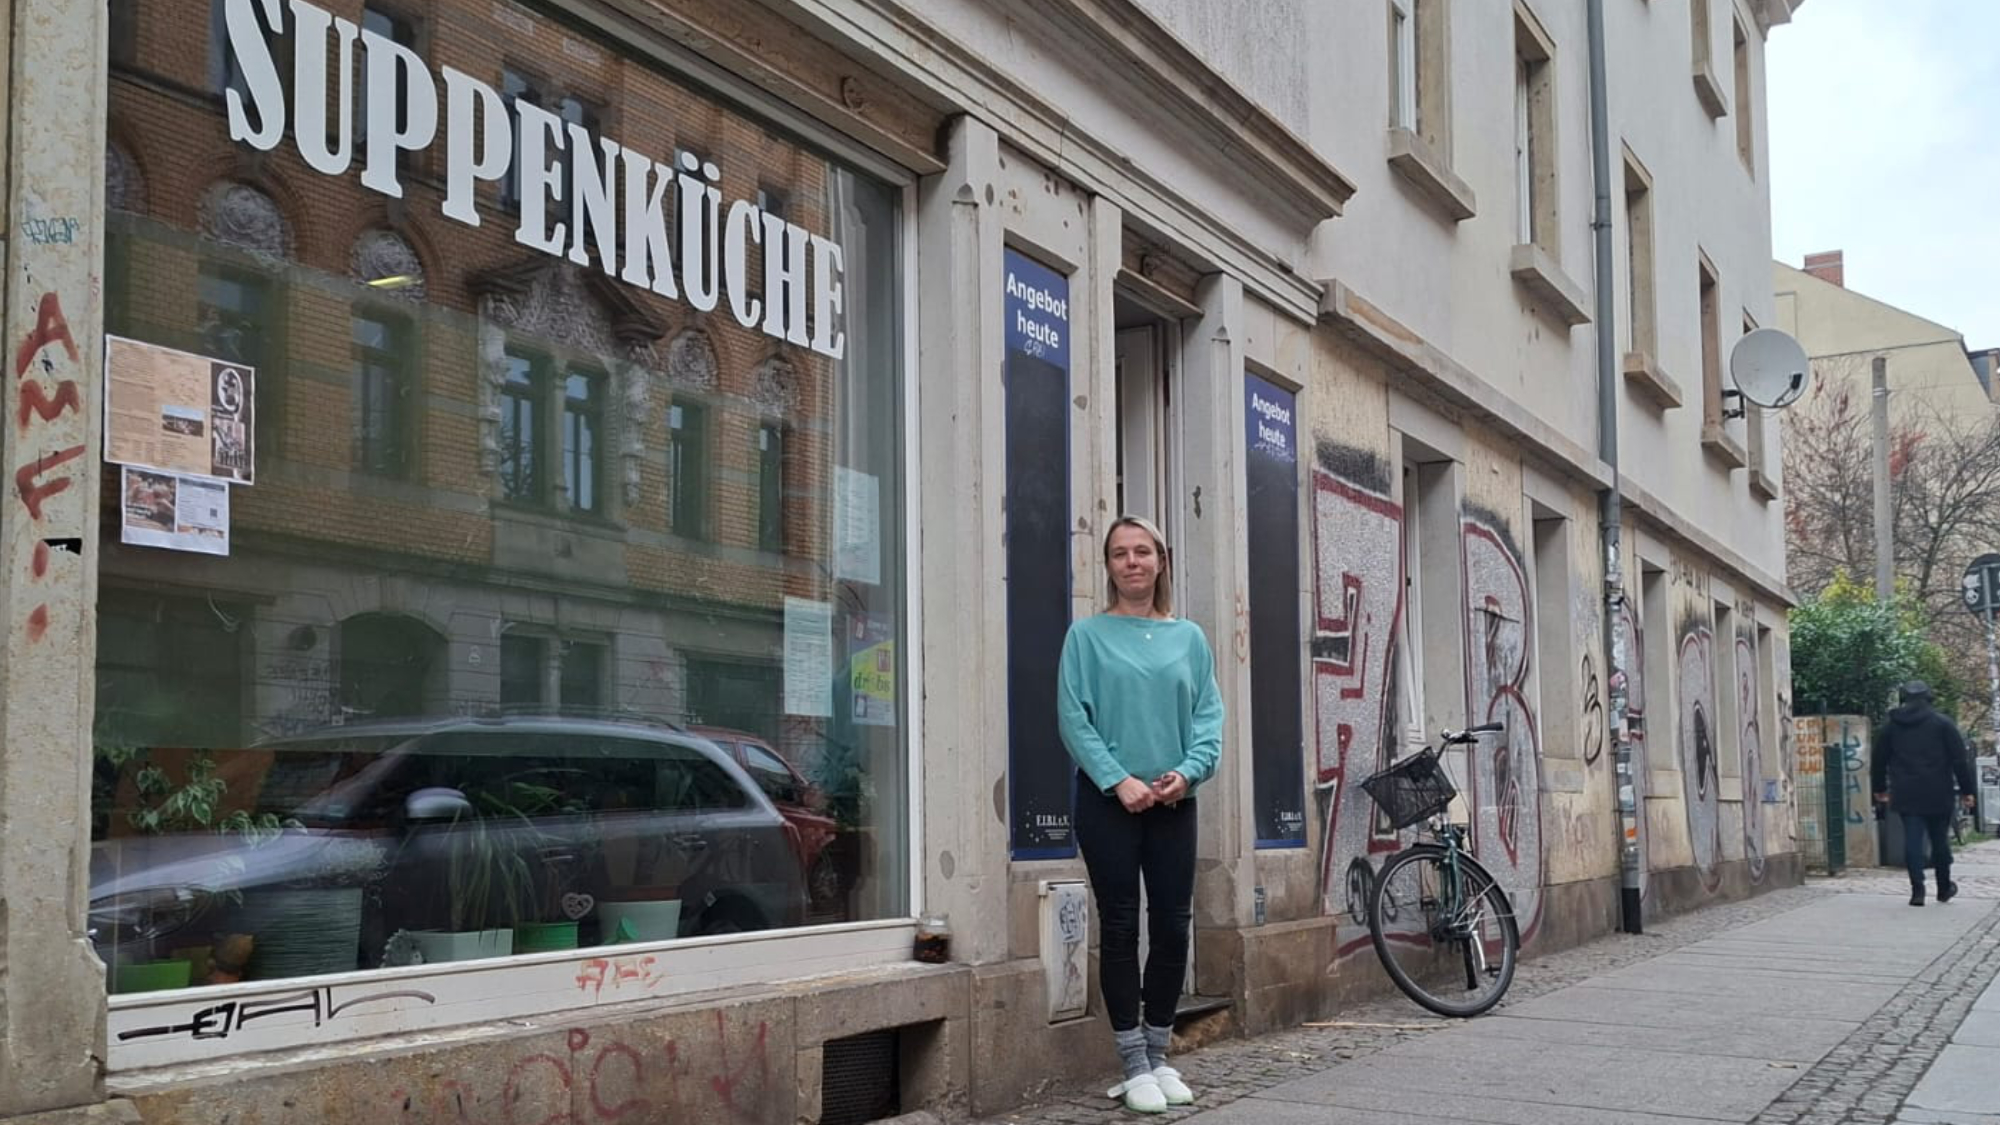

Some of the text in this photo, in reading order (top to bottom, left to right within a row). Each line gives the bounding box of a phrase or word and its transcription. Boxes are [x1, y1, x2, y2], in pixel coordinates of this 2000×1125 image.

[225, 0, 844, 360] SUPPENKÜCHE
[1006, 272, 1067, 321] Angebot
[1016, 309, 1059, 348] heute
[1251, 392, 1291, 426] Angebot
[1258, 420, 1286, 447] heute
